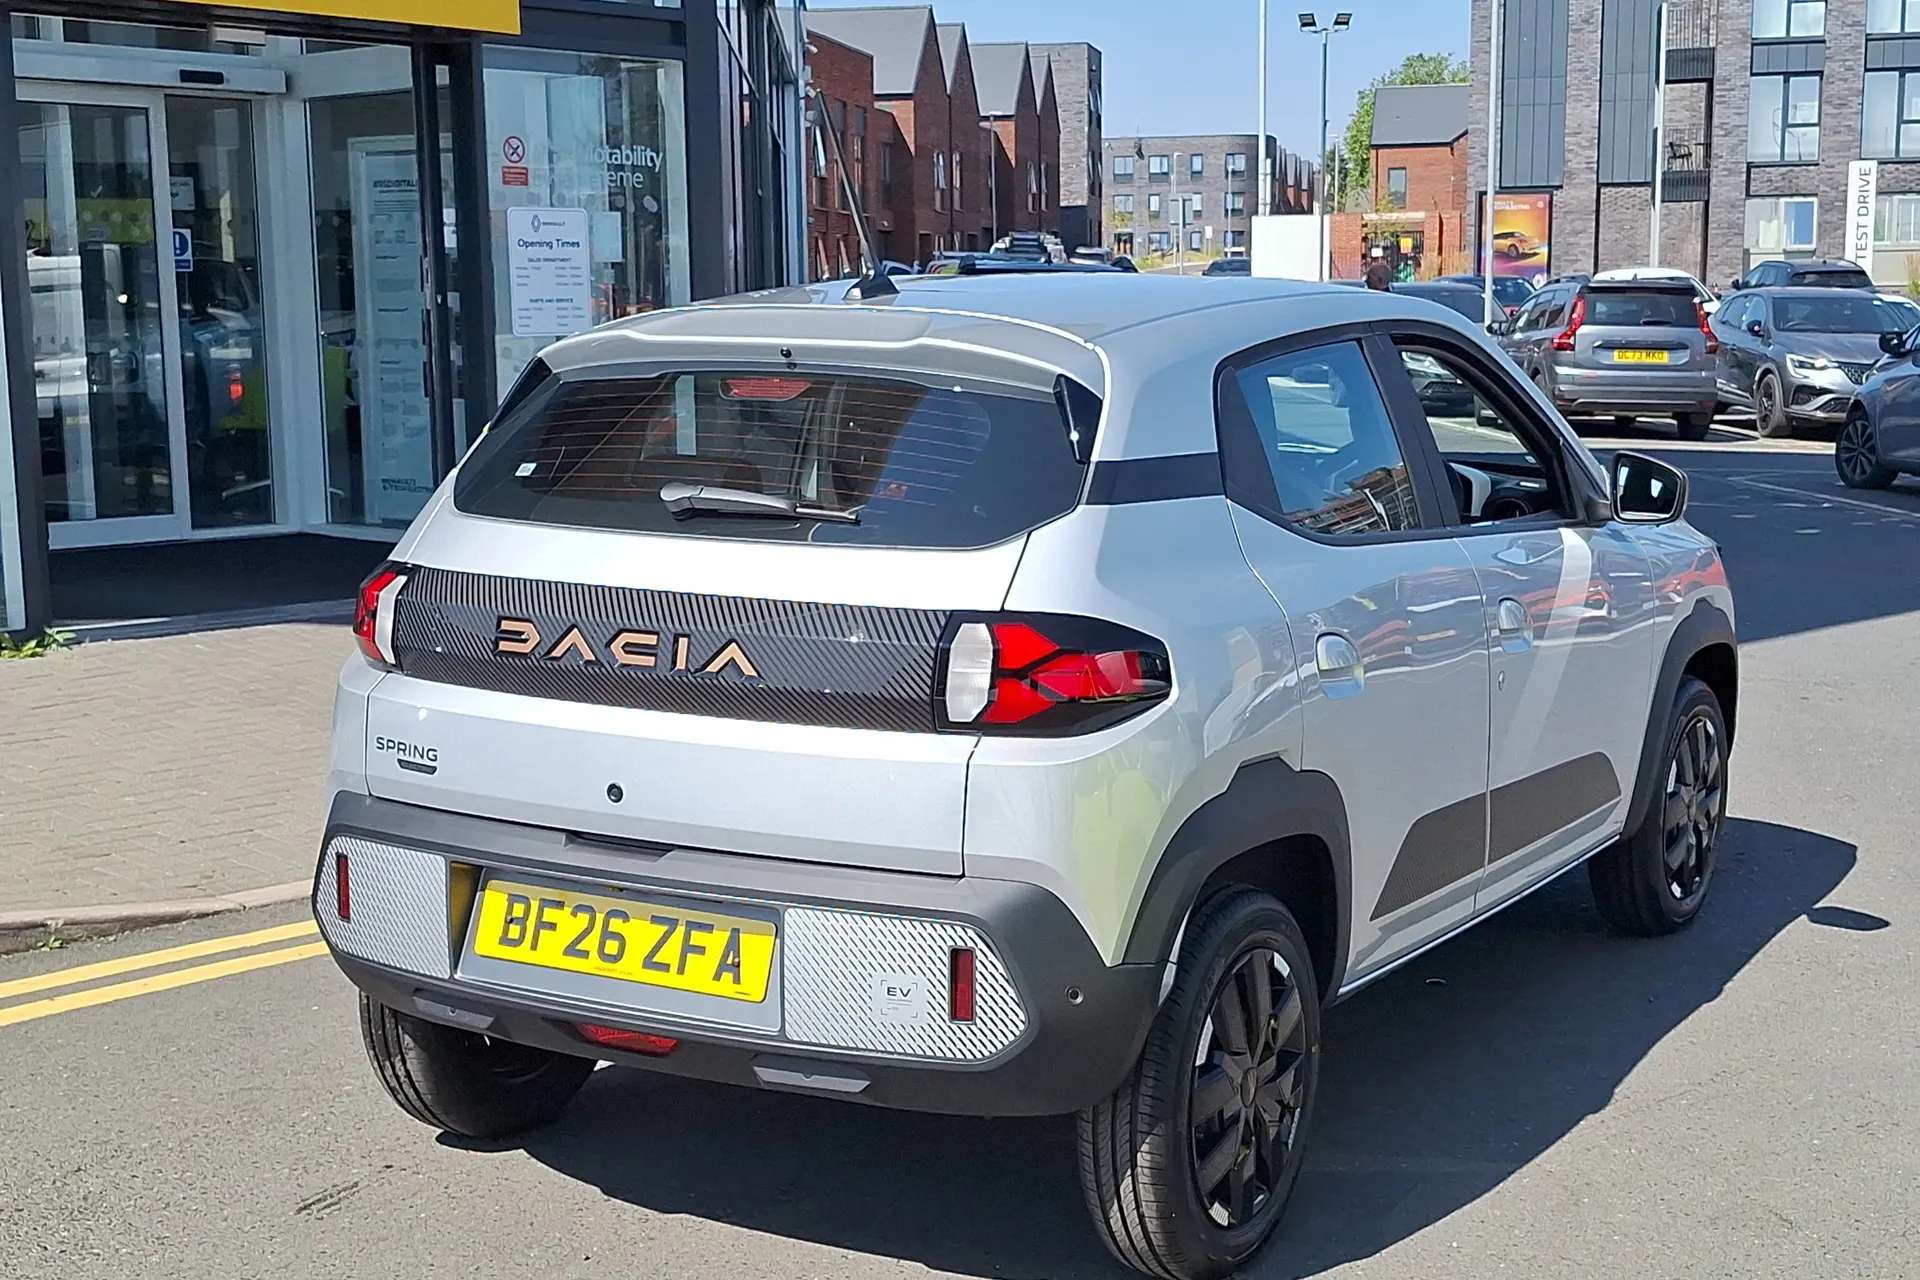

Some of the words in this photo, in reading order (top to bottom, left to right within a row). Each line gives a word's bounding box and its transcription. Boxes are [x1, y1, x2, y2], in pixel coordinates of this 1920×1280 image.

[592, 144, 663, 173] otability
[1857, 166, 1872, 217] DRIVE
[517, 238, 554, 250] Opening
[555, 239, 581, 249] Times
[1855, 221, 1869, 263] TEST
[495, 616, 763, 682] DACIA
[375, 736, 439, 763] SPRING
[498, 893, 631, 965] BF26
[641, 914, 742, 986] ZFA
[886, 986, 913, 998] EV
